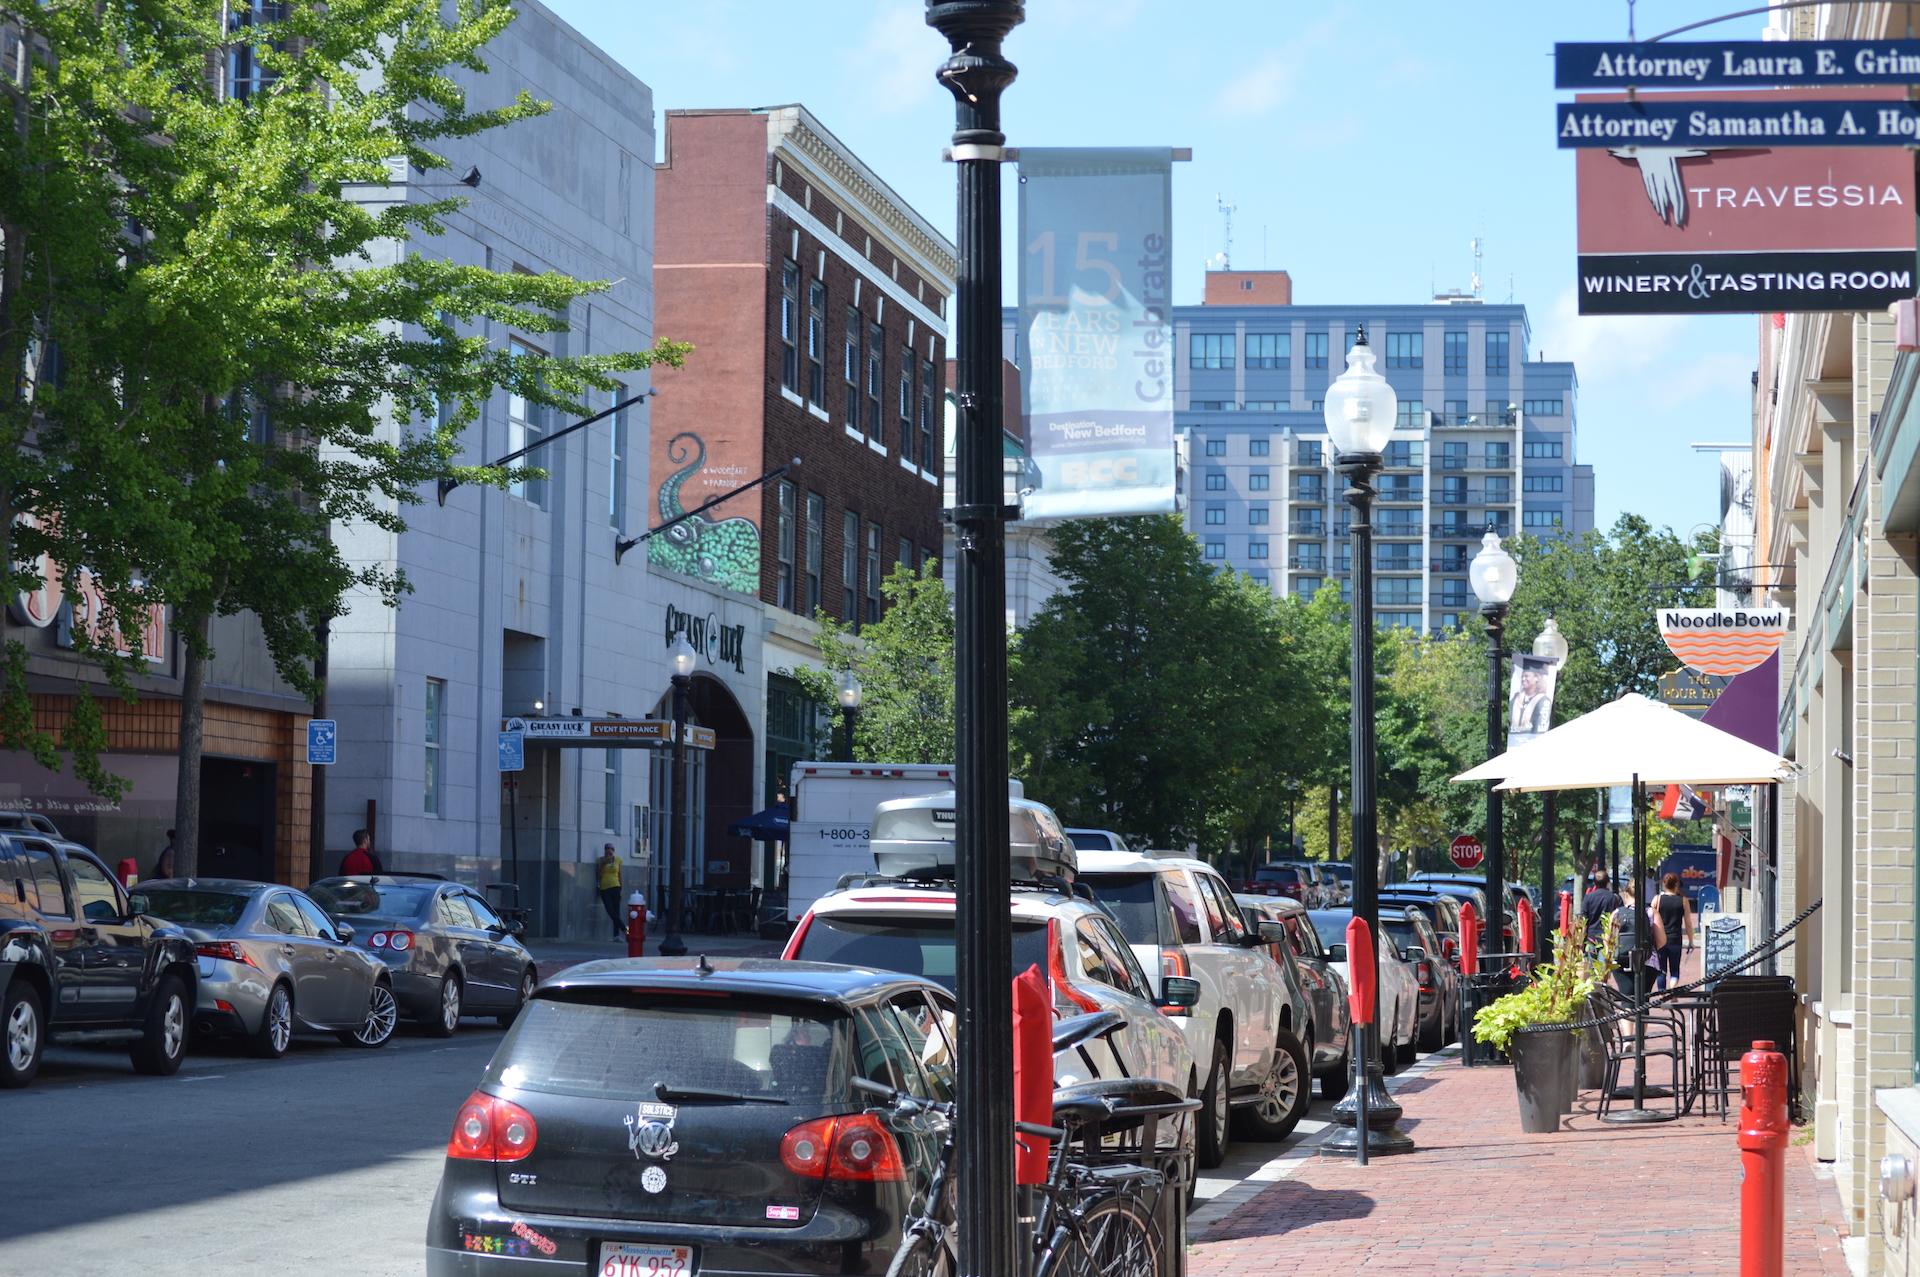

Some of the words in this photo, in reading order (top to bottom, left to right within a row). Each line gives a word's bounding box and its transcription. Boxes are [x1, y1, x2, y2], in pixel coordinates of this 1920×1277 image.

[1593, 52, 1712, 81] Attorney
[1722, 51, 1804, 77] Laura
[1816, 50, 1844, 75] E.
[1560, 113, 1678, 141] Attorney
[1689, 110, 1826, 137] Samantha
[1837, 110, 1866, 135] A.
[1689, 185, 1903, 208] TRAVESSIA
[1027, 231, 1123, 307] 15
[1583, 275, 1688, 293] WINERY
[1688, 264, 1710, 299] &
[1705, 272, 1825, 291] TASTING
[1830, 271, 1910, 290] ROOM
[1026, 309, 1120, 332] YEARS
[1133, 233, 1165, 403] Celebrate
[1031, 337, 1046, 349] IN
[1049, 332, 1120, 354] NEW
[1031, 354, 1118, 370] BEDFORD
[1049, 420, 1096, 431] Destination
[1064, 427, 1091, 440] New
[1095, 424, 1146, 437] Bedford
[1061, 457, 1138, 485] BCC
[1666, 612, 1781, 628] NoodleBowl
[720, 624, 745, 674] LUCK
[1688, 675, 1710, 684] THE
[1663, 688, 1697, 699] POUR
[530, 722, 561, 731] GREASY
[563, 722, 585, 732] LUCK
[594, 725, 618, 733] EVENT
[936, 811, 956, 820] THU
[819, 829, 870, 840] 1-800-3
[1452, 845, 1481, 859] STOP
[642, 1104, 674, 1116] SOLSTICE
[509, 1173, 537, 1185] GTI
[622, 1245, 672, 1256] Massachusetts
[604, 1255, 641, 1277] 6YK
